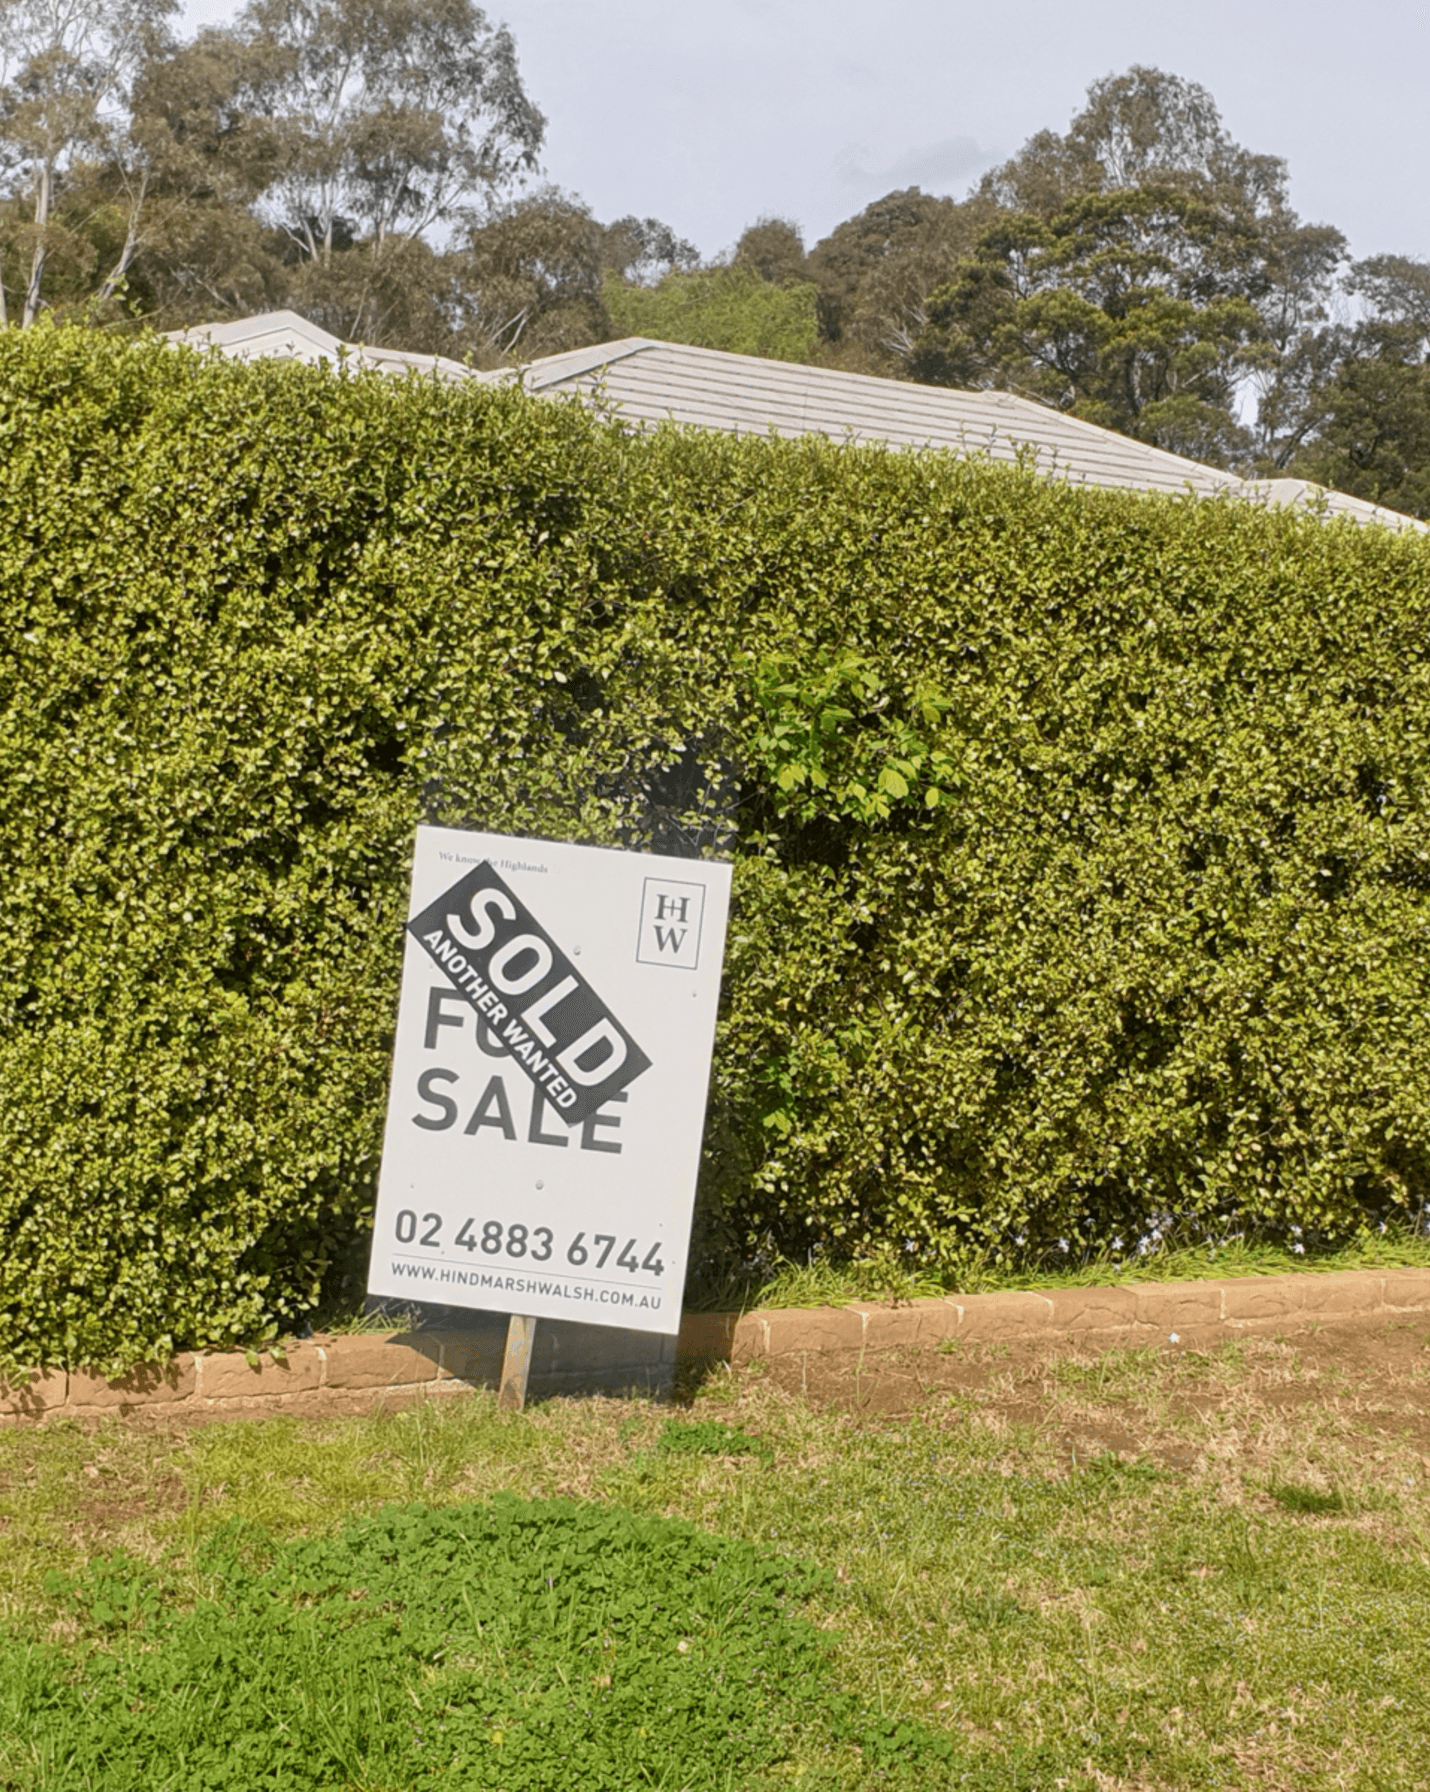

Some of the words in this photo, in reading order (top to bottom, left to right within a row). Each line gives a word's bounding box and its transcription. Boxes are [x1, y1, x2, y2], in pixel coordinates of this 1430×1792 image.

[439, 851, 454, 861] We
[500, 859, 548, 873] Highlands
[423, 930, 508, 1026] ANOTHER
[502, 1018, 578, 1108] WANTED
[446, 887, 628, 1087] SOLD
[411, 1067, 629, 1154] SALE
[395, 1209, 443, 1247] 02
[454, 1217, 554, 1261] 4883
[566, 1231, 665, 1276] 6744
[391, 1262, 662, 1311] WWW.HINDMARSHWALSH.COM.AU
